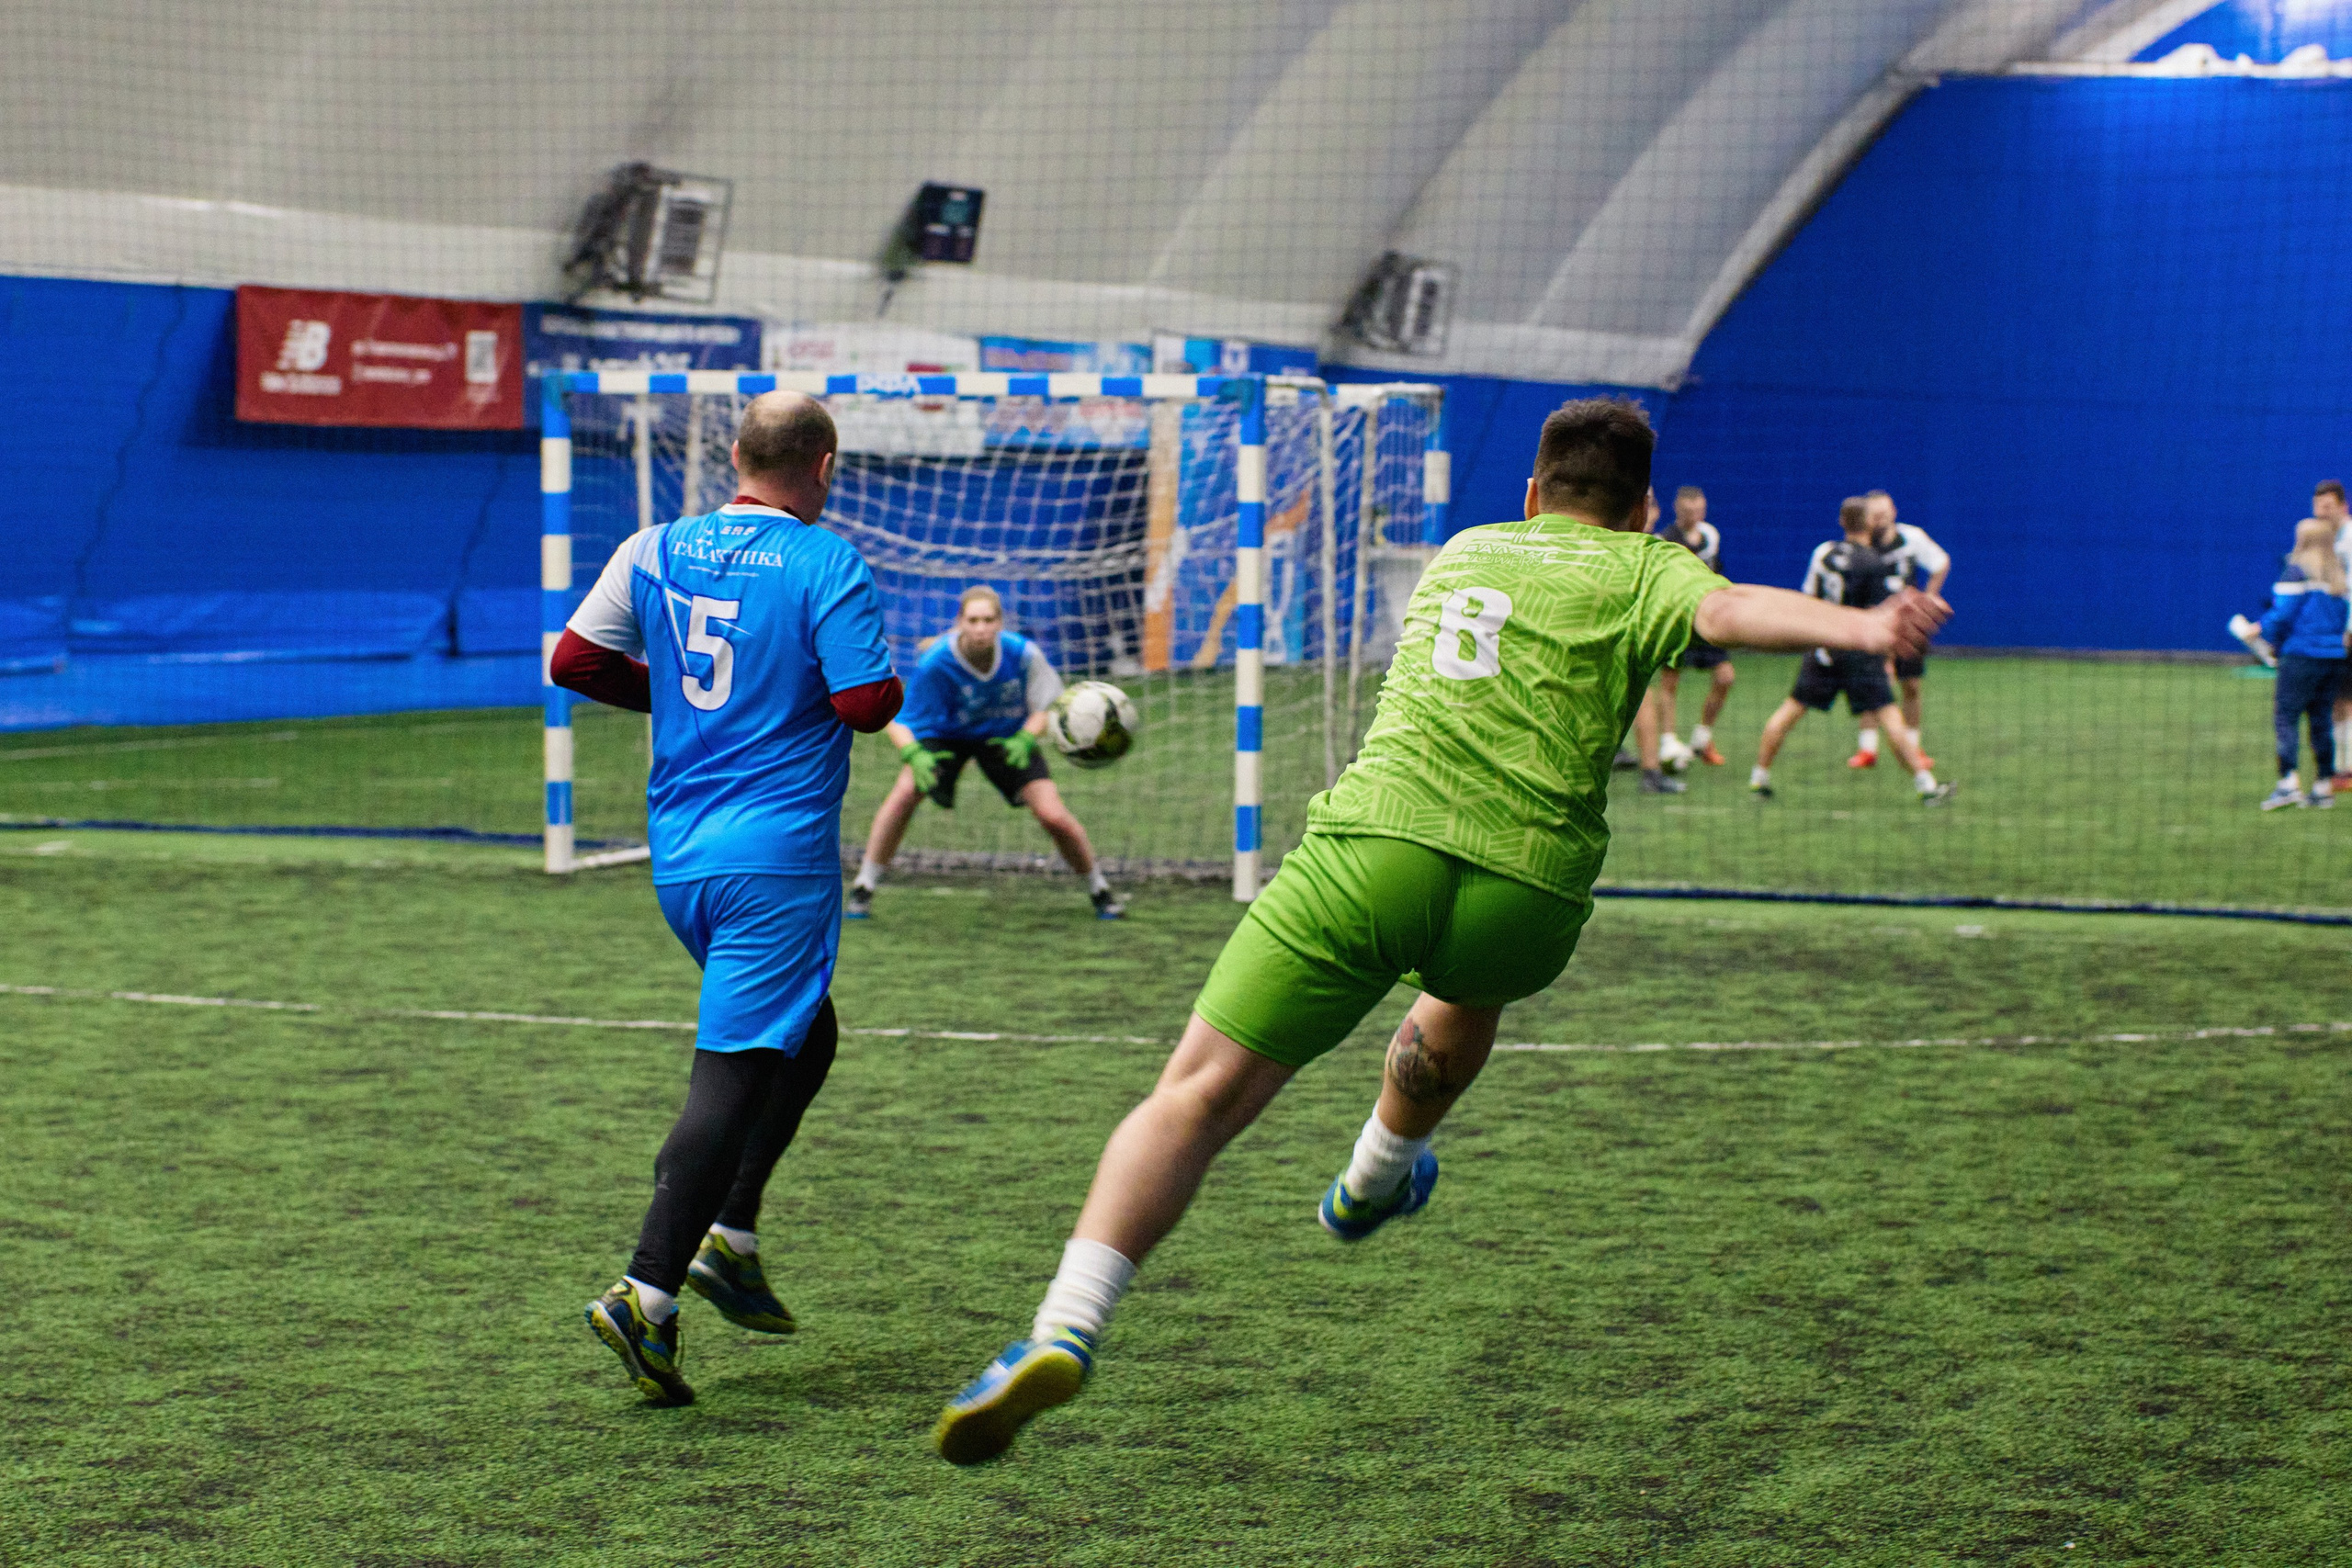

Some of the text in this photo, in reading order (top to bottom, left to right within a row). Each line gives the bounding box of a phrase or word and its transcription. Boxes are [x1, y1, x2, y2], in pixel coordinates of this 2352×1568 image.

[672, 541, 784, 568] ГАЛАКТИКА
[1467, 554, 1542, 567] TOWERS
[682, 595, 740, 710] 5
[1432, 586, 1512, 680] 8
